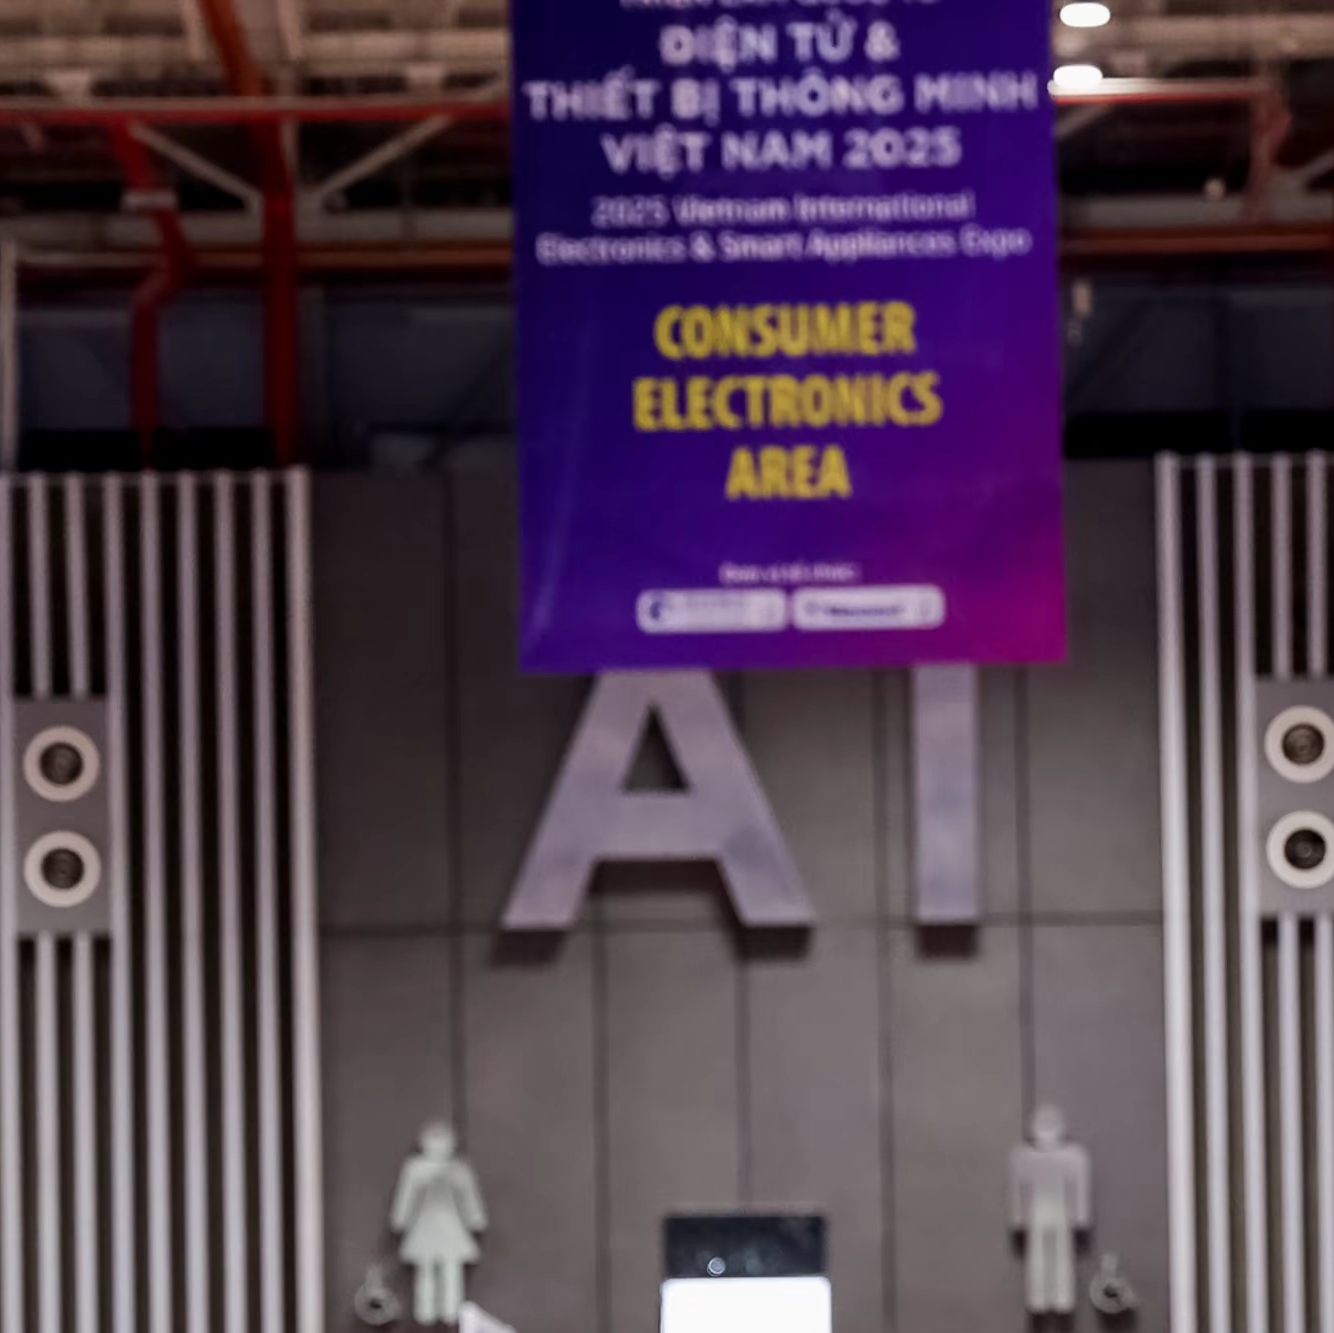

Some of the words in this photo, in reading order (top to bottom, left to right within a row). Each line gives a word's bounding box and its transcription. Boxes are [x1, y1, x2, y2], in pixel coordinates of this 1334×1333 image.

[864, 21, 900, 60] &
[670, 78, 721, 125] BỊ
[730, 67, 903, 115] THÔNG
[914, 71, 1038, 113] MINH
[600, 123, 712, 180] VIỆT
[721, 131, 832, 171] NAM
[842, 126, 961, 168] 2025
[653, 301, 916, 359] CONSUMER
[632, 370, 943, 431] ELECTRONICS
[725, 445, 852, 500] AREA
